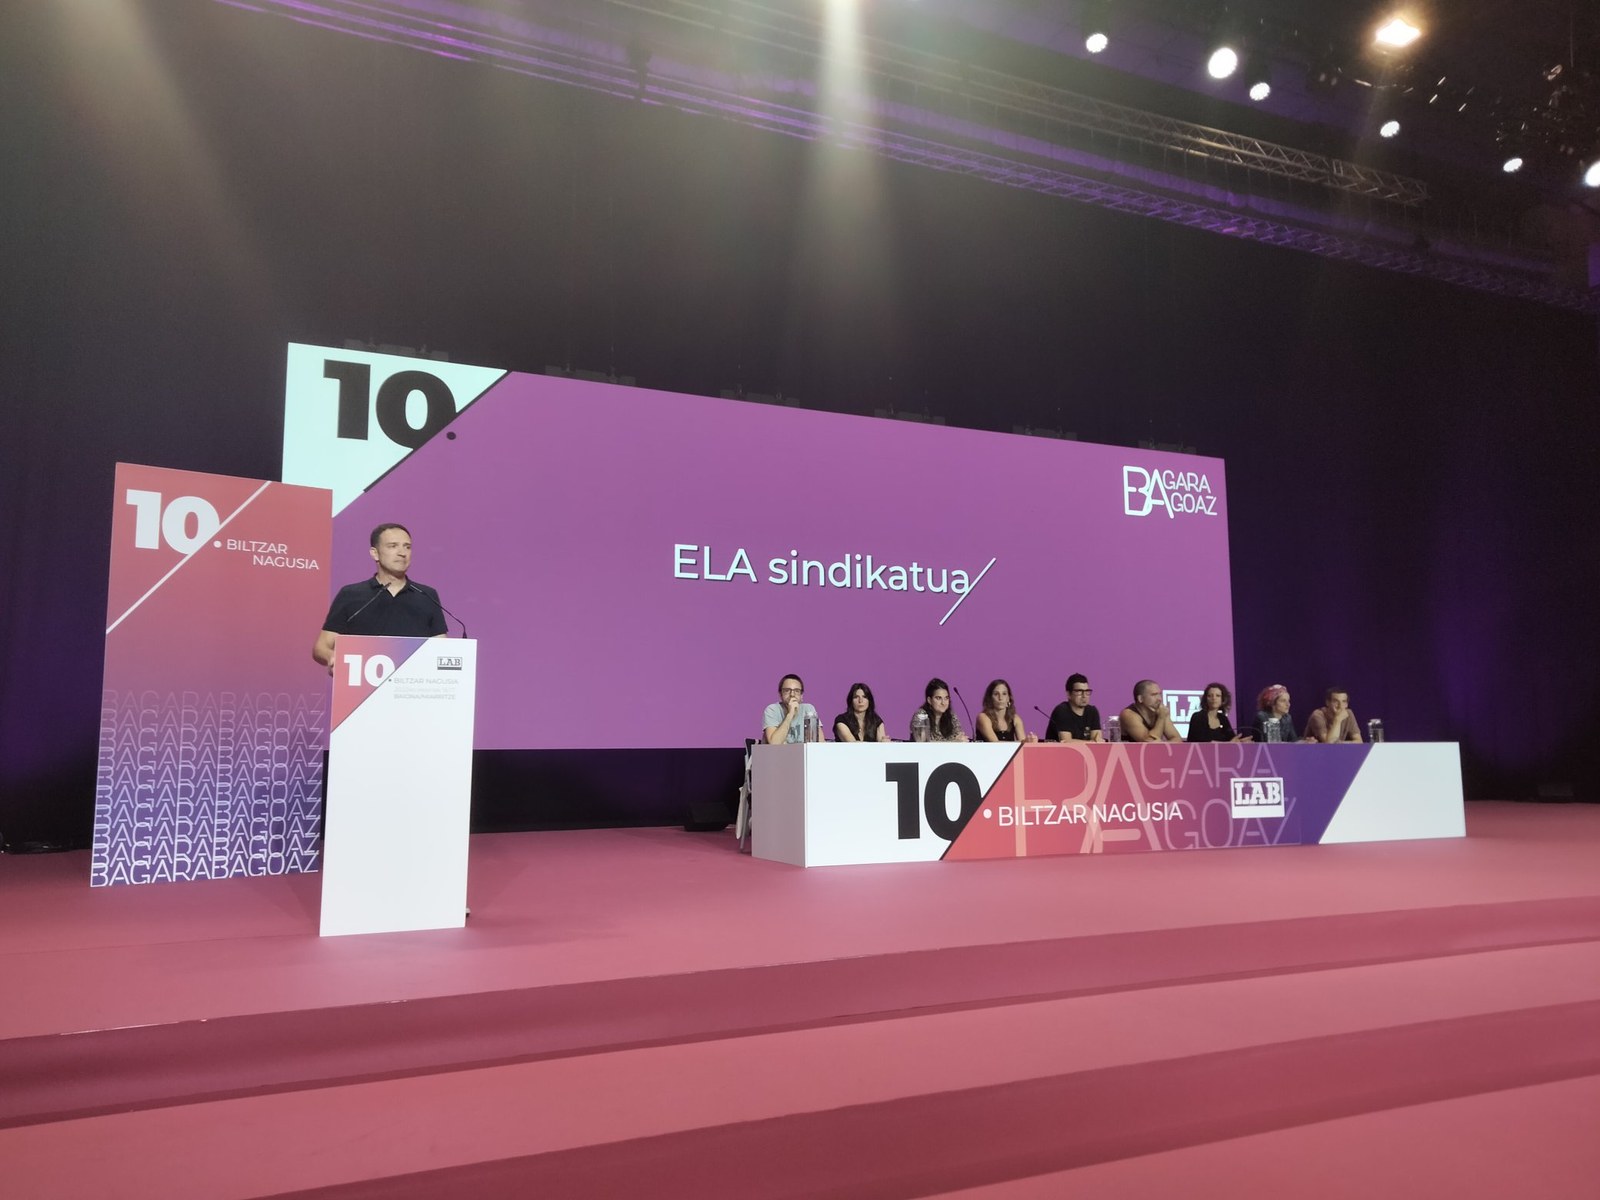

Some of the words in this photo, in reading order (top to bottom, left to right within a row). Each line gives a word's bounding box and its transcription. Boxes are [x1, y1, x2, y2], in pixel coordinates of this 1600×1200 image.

[226, 538, 288, 554] BILTZAR
[252, 555, 319, 570] NAGUSIA
[674, 543, 757, 582] ELA
[768, 549, 970, 594] sindikatua
[1233, 782, 1281, 806] LAB
[998, 804, 1087, 827] BILTZAR
[1092, 802, 1184, 823] NAGUSIA
